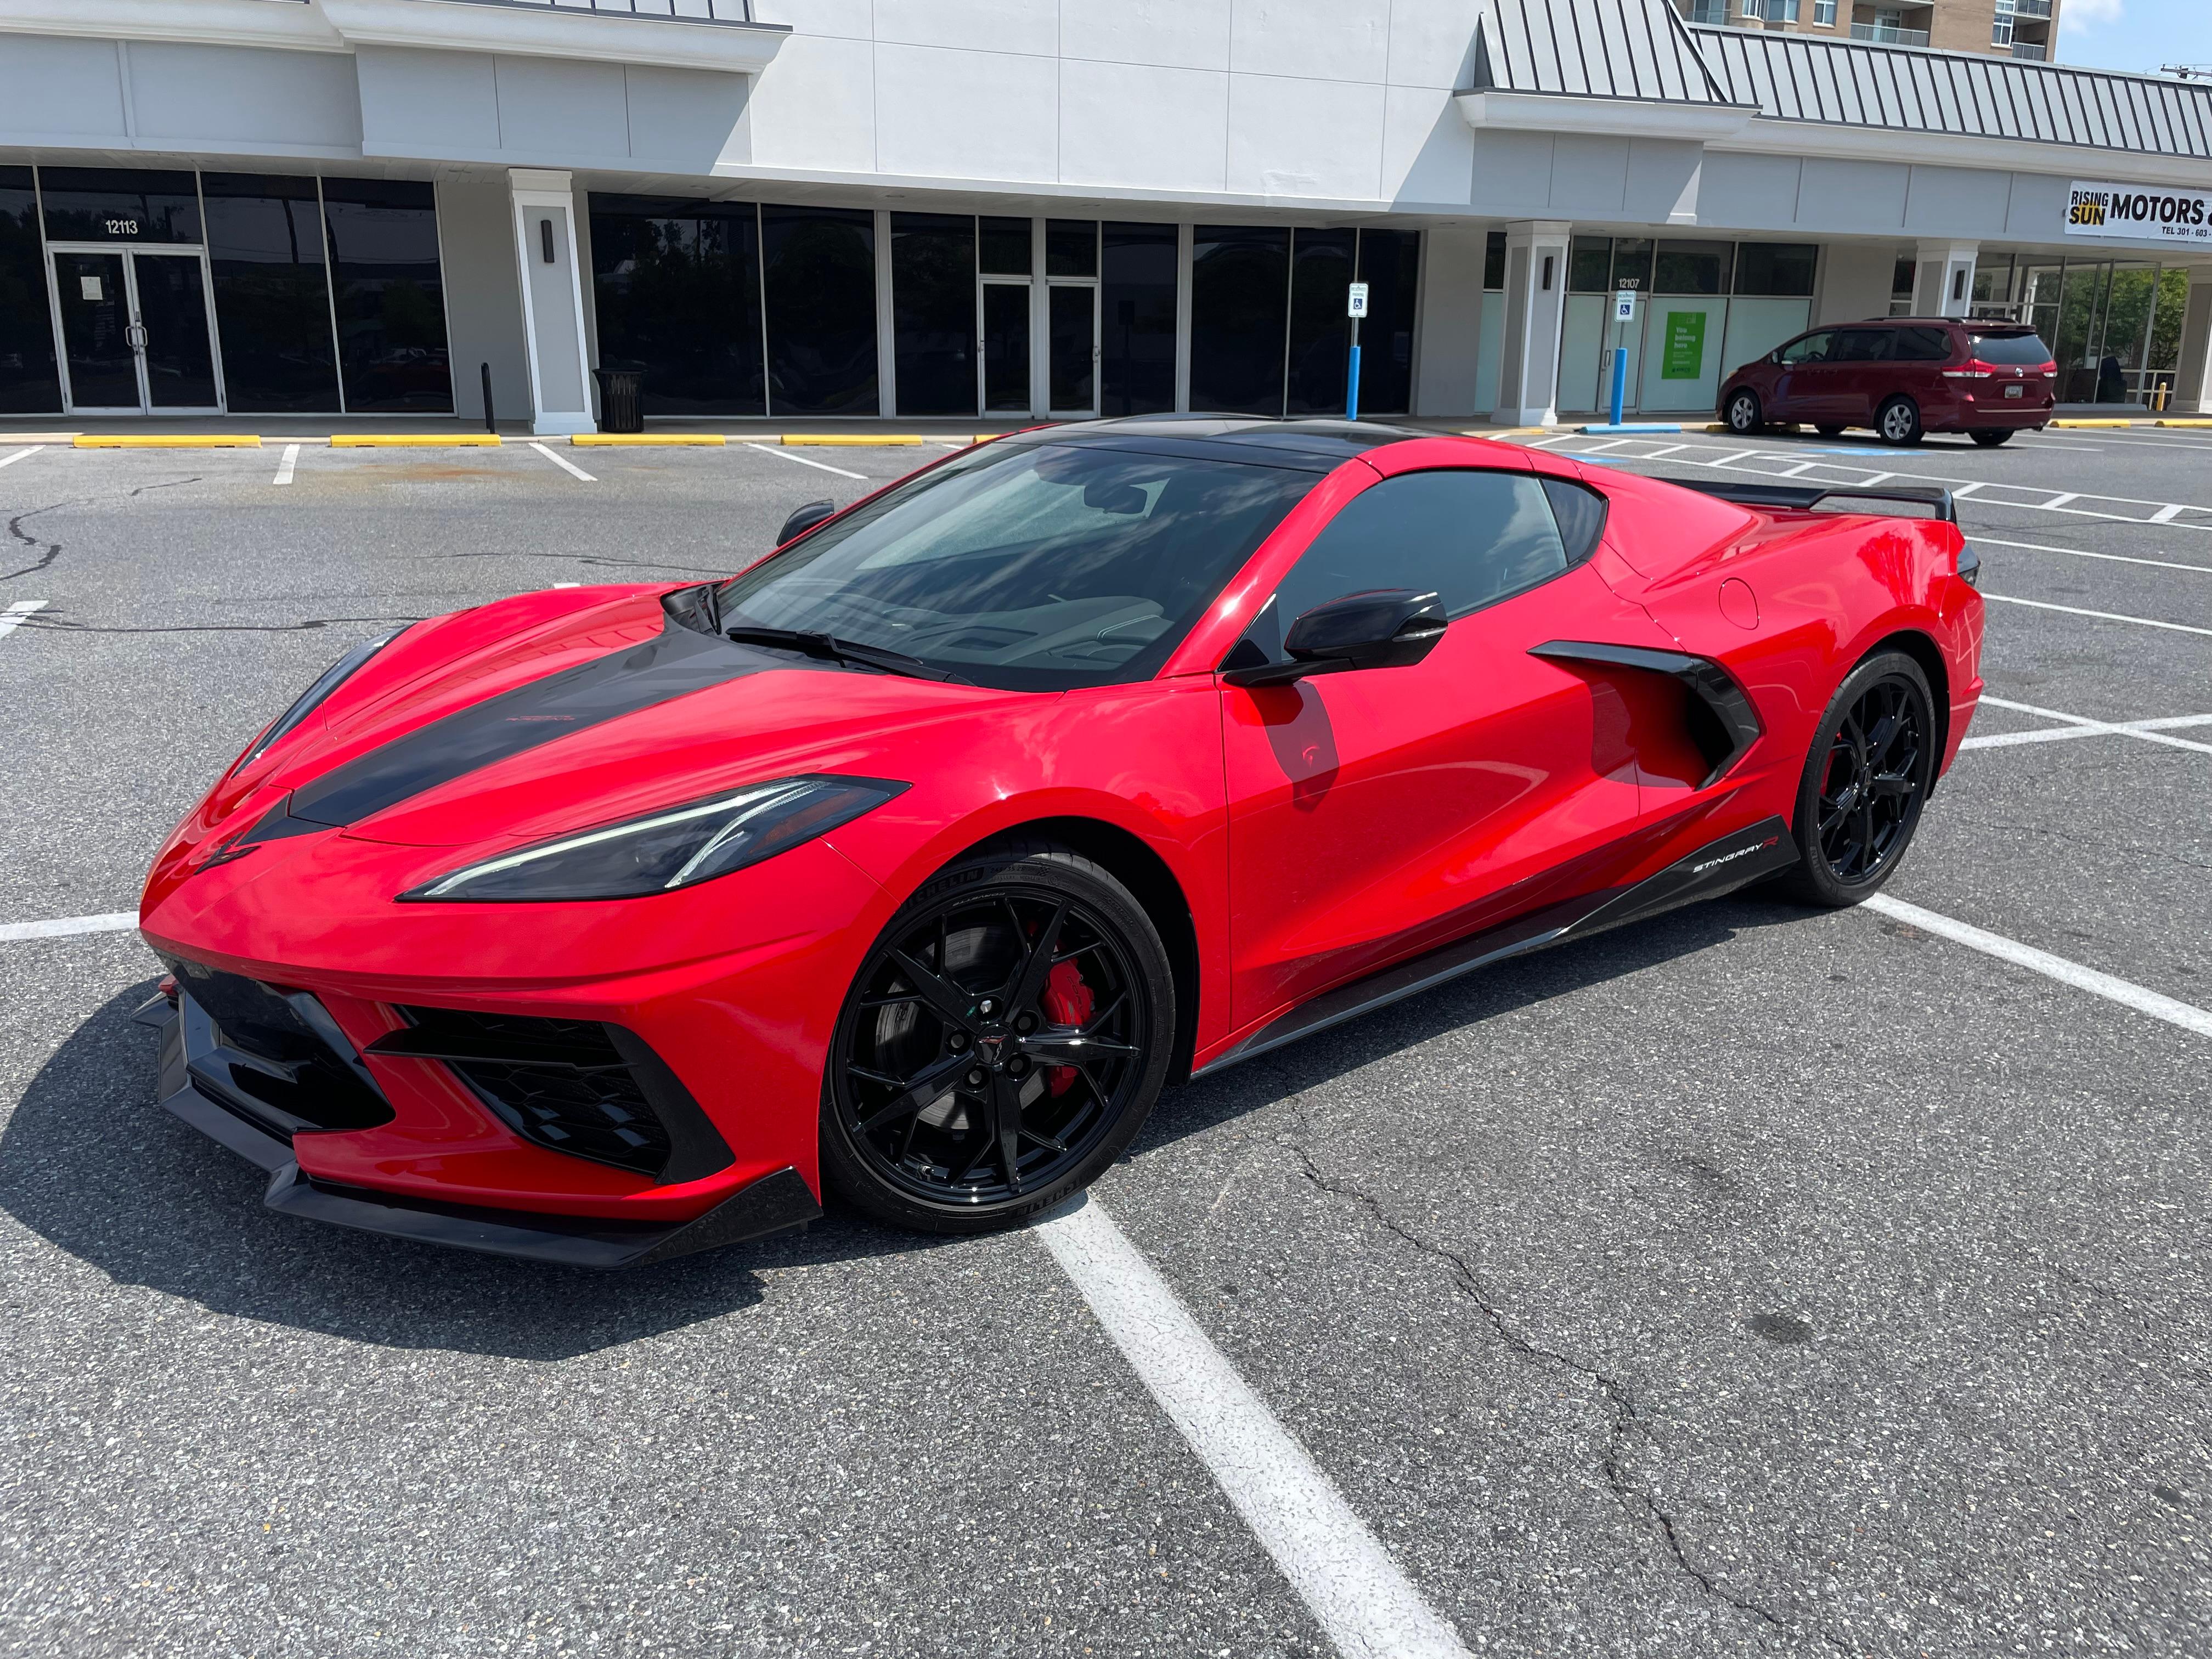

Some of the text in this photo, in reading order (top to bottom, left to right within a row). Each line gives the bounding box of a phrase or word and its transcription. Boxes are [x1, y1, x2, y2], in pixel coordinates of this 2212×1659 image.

[2070, 190, 2109, 207] RISING
[2069, 206, 2106, 225] SUN
[2110, 193, 2204, 225] MOTORS
[105, 219, 138, 234] 12113
[2162, 226, 2175, 235] TEL
[2177, 227, 2190, 235] 301
[2195, 229, 2207, 237] 603
[1618, 278, 1640, 289] 12107
[1692, 842, 1763, 873] STINGRAY
